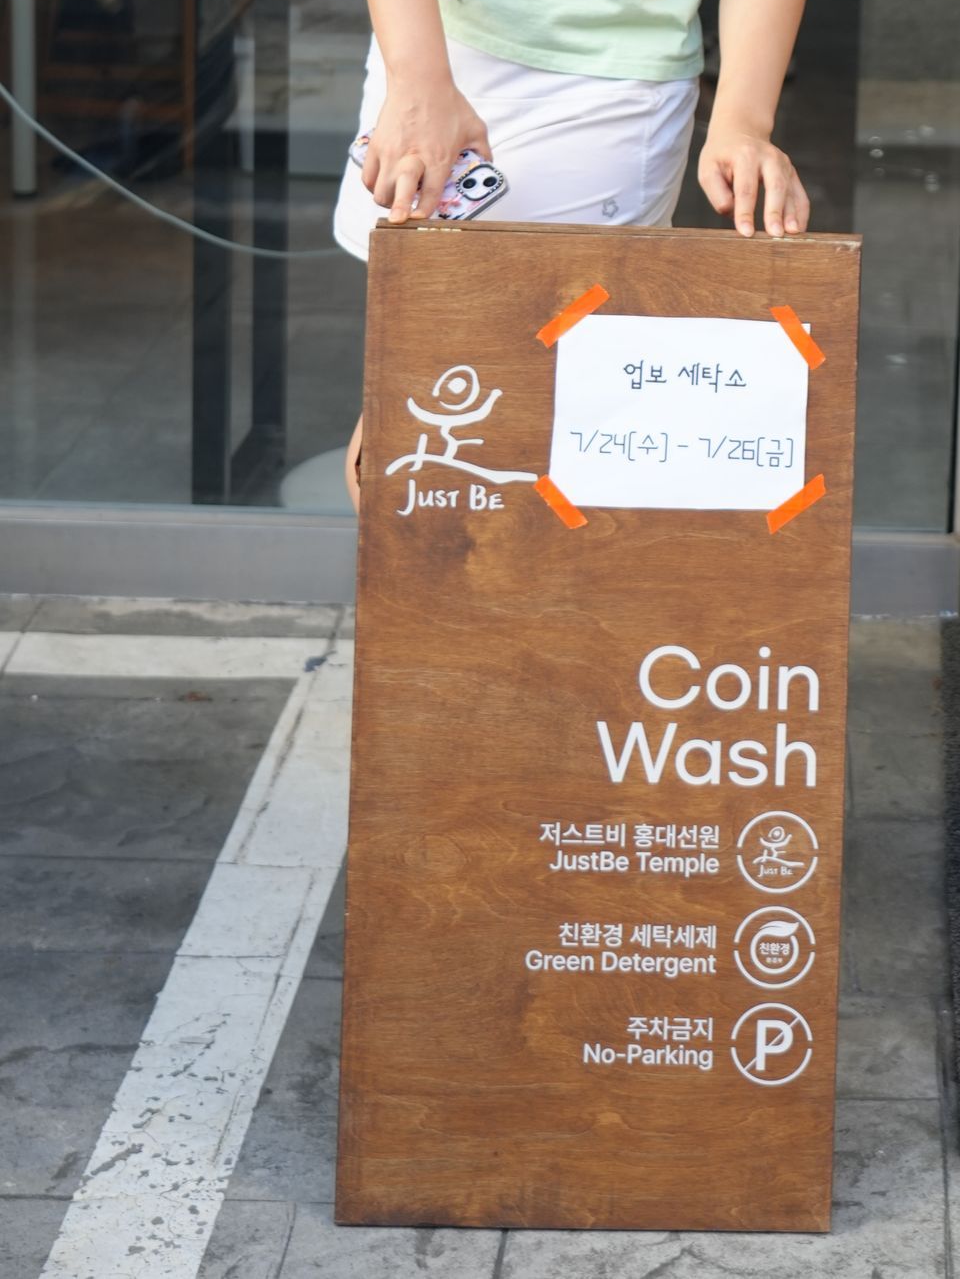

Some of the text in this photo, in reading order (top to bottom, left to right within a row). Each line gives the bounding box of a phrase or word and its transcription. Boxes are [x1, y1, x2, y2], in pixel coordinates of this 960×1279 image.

[623, 360, 748, 394] 업보 세탁소
[638, 644, 820, 712] Coin
[596, 720, 817, 788] Wash
[539, 821, 720, 850] 저스트비 홍대선원
[549, 849, 720, 878] JustBe Temple
[558, 922, 717, 950] 친환경 세탁세제
[759, 941, 791, 956] 친환경
[524, 949, 717, 978] Green Detergent
[626, 1016, 714, 1041] 주차금지
[583, 1043, 714, 1071] No-Parking
[755, 1019, 794, 1071] P
